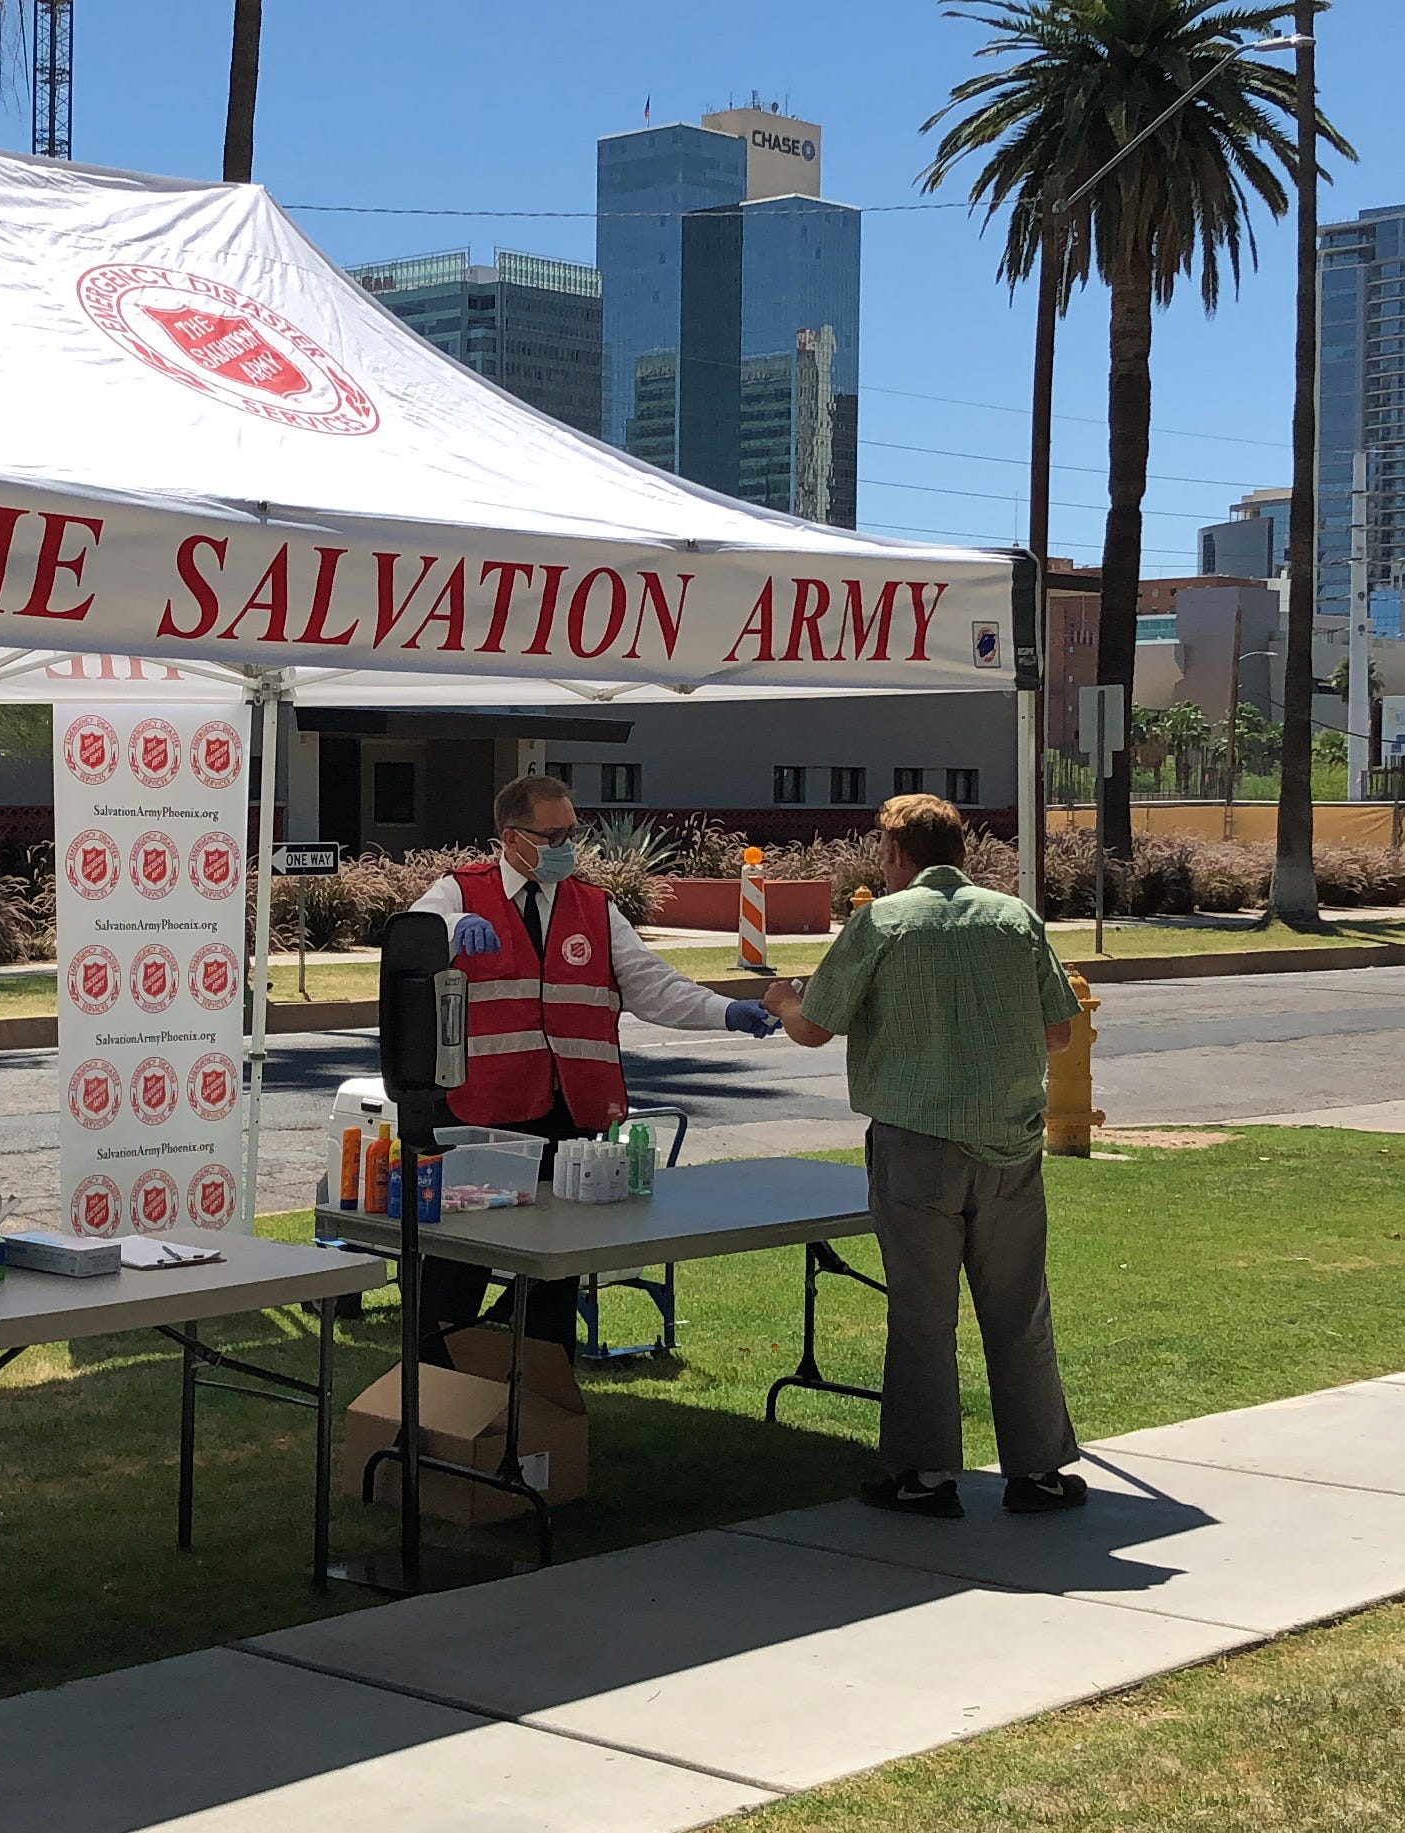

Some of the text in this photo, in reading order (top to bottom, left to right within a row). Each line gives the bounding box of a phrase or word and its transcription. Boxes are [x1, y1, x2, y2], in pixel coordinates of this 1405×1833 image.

[752, 129, 801, 156] CHASE
[91, 267, 326, 359] EMERGENCY DISASTER
[173, 315, 216, 341] THE
[190, 322, 260, 369] SALVATION
[239, 352, 285, 386] ARMY
[241, 399, 367, 433] SERVICES
[156, 533, 695, 661] SALVATION
[723, 575, 950, 663] ARMY
[93, 805, 219, 822] SalvationArmyPhoenix.org
[286, 853, 332, 866] ONE WAY
[95, 918, 217, 933] SalvationArmyPhoenix.org
[95, 1030, 216, 1046] SalvationArmyPhoenix.org
[97, 1141, 215, 1160] SalvationArmyPhoenix.org
